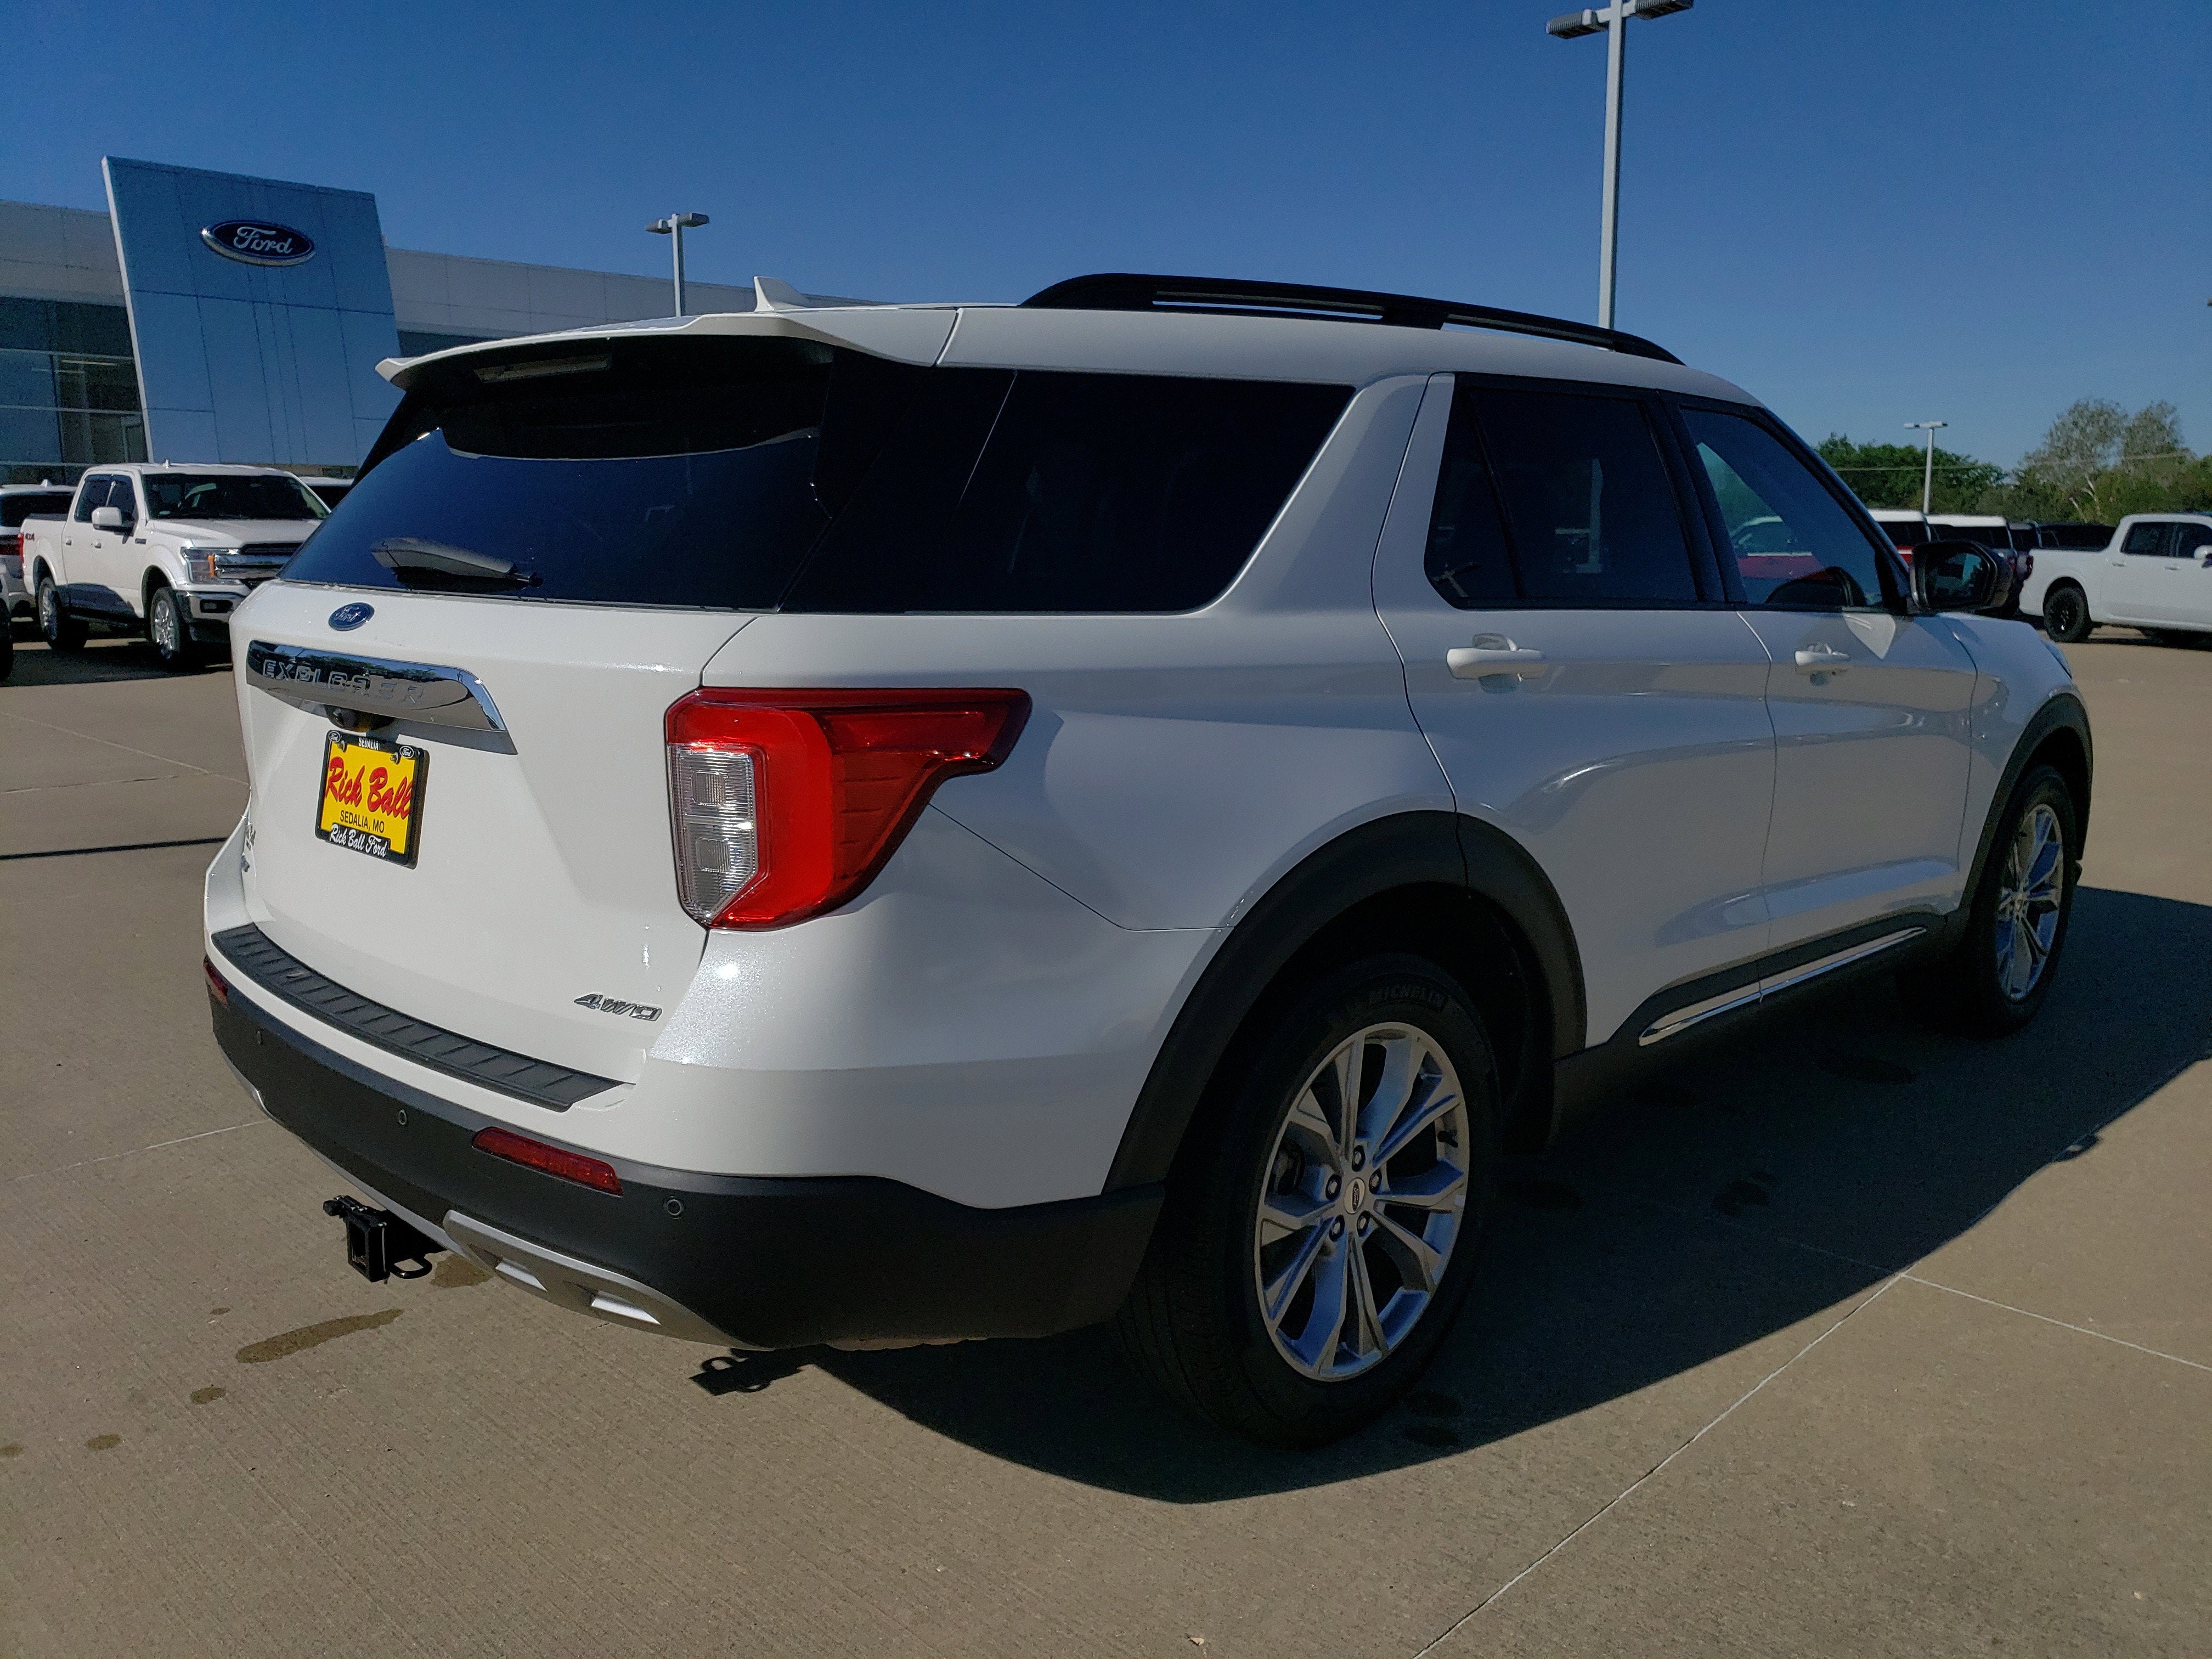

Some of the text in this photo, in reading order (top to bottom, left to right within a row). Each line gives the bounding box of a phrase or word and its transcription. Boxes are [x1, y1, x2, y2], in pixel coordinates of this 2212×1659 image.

[233, 226, 293, 254] Ford
[263, 659, 424, 704] EXPLORER
[358, 737, 379, 751] SEDALIA
[325, 757, 414, 819] Rick Ball
[340, 810, 384, 833] SEDALIA, MO
[330, 825, 386, 857] Rick Ball Ford
[574, 994, 662, 1022] 4WD
[1368, 984, 1446, 1008] MICHELIN
